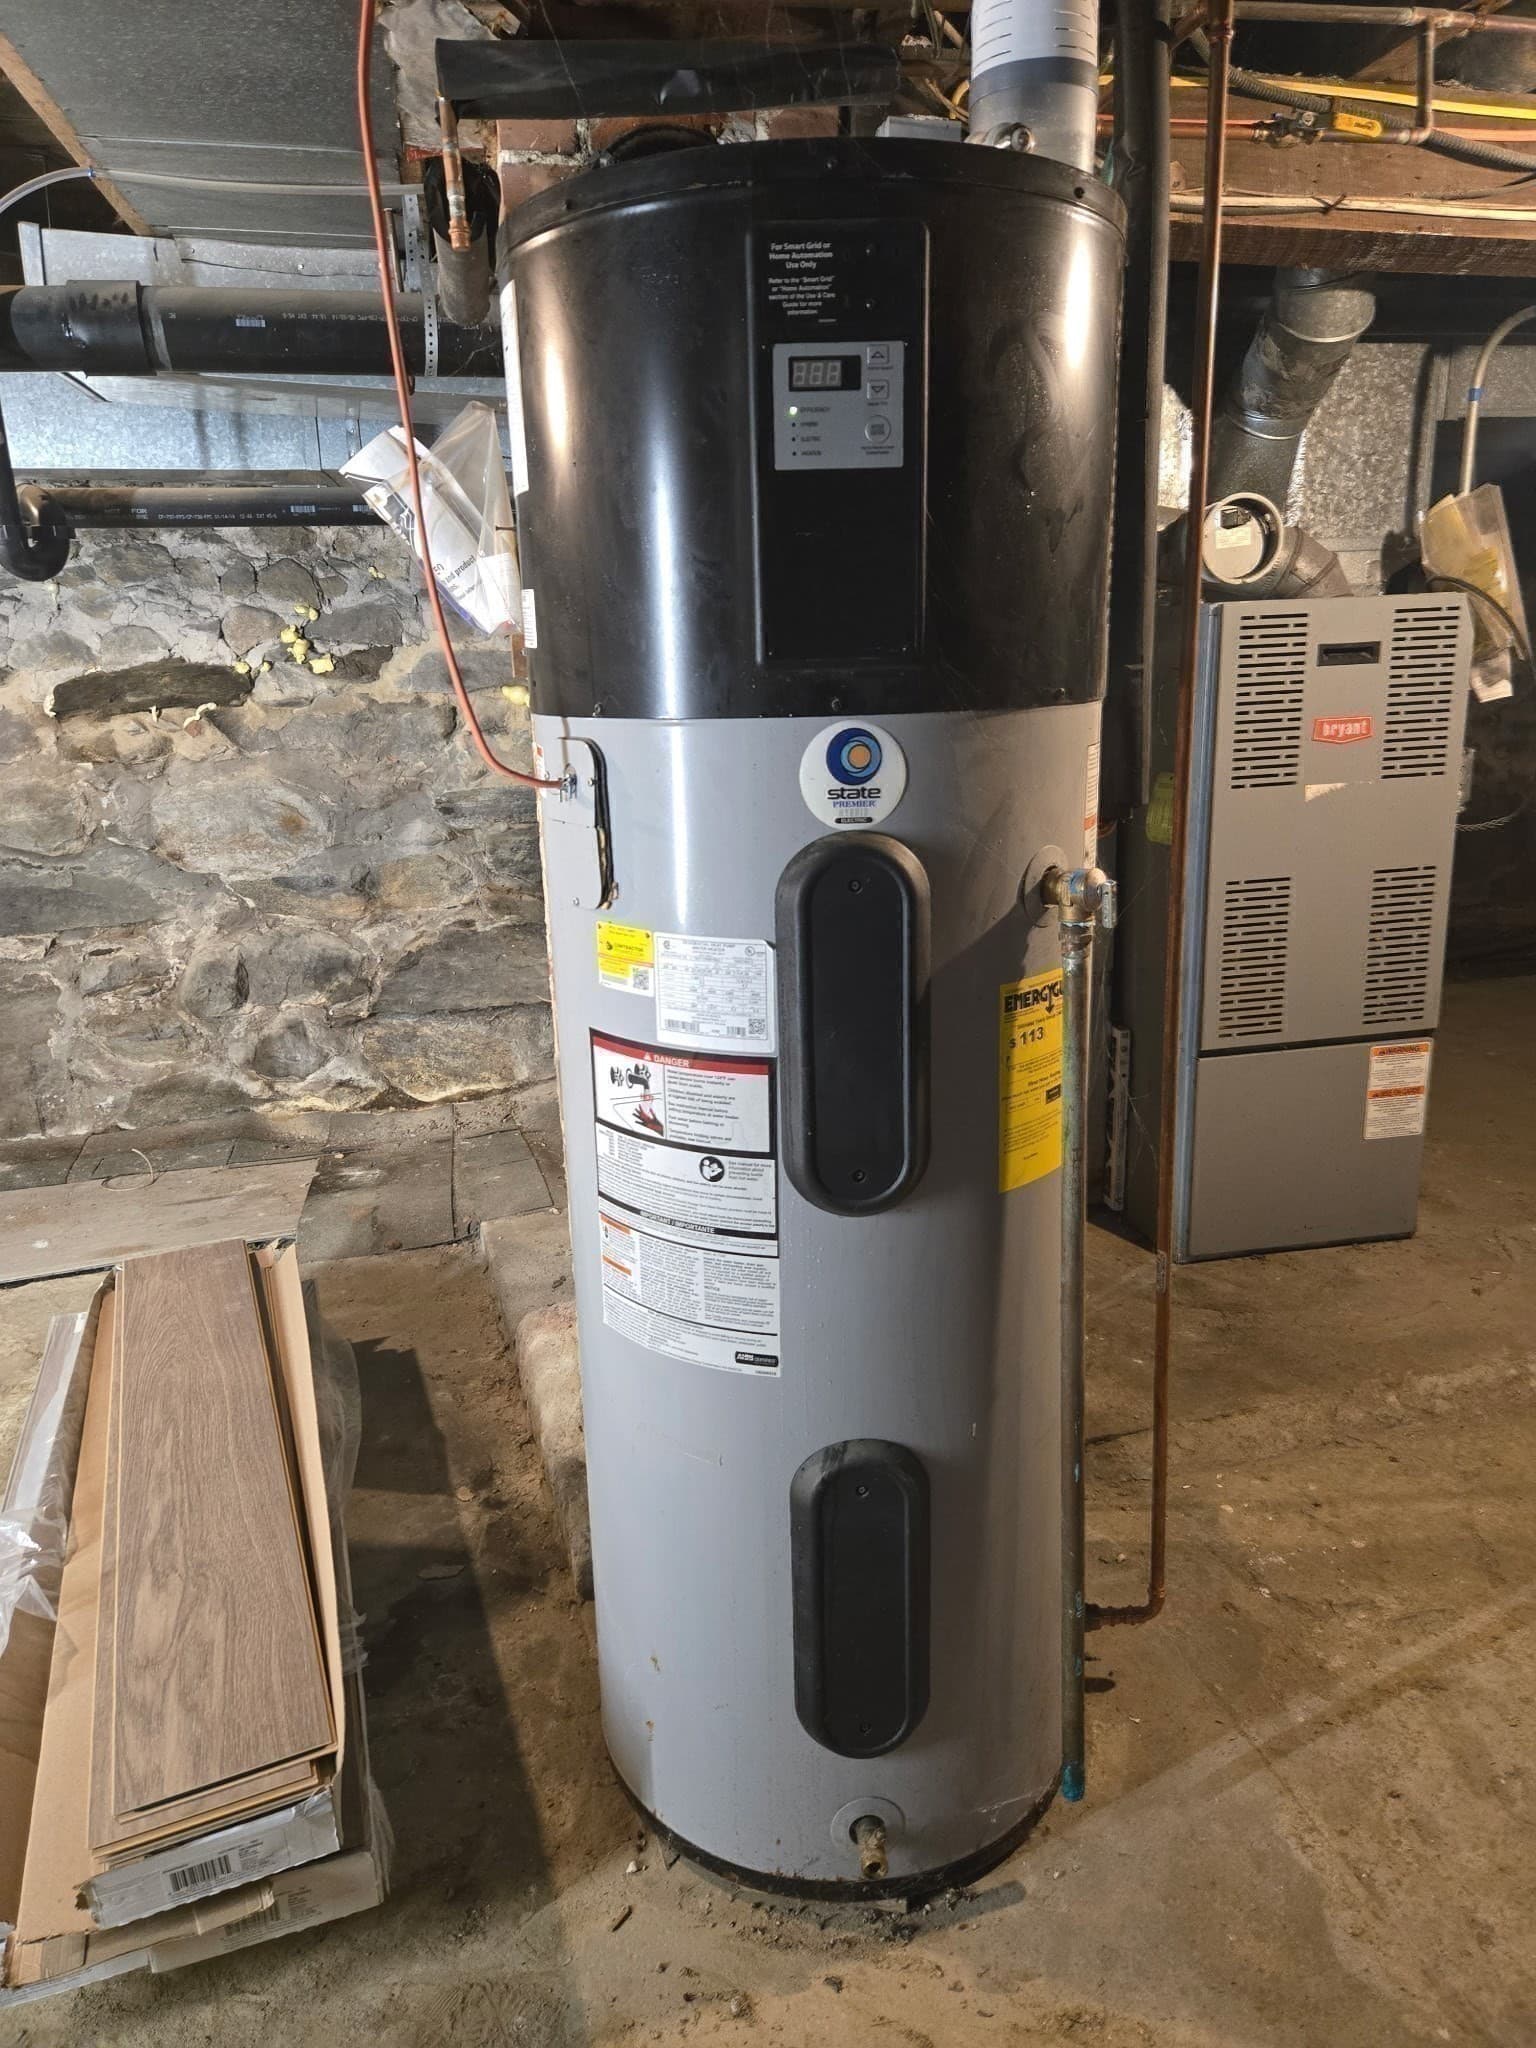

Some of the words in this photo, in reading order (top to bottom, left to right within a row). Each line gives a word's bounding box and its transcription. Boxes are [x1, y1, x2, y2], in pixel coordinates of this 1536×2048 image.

[800, 260, 816, 269] Only
[1322, 720, 1368, 738] bryant
[826, 787, 882, 800] state
[832, 800, 877, 808] PREMIER
[1020, 1026, 1044, 1044] 113
[653, 1055, 690, 1068] DANGER
[640, 1210, 670, 1225] IMPORTANT
[675, 1220, 715, 1233] IMPORTANTE
